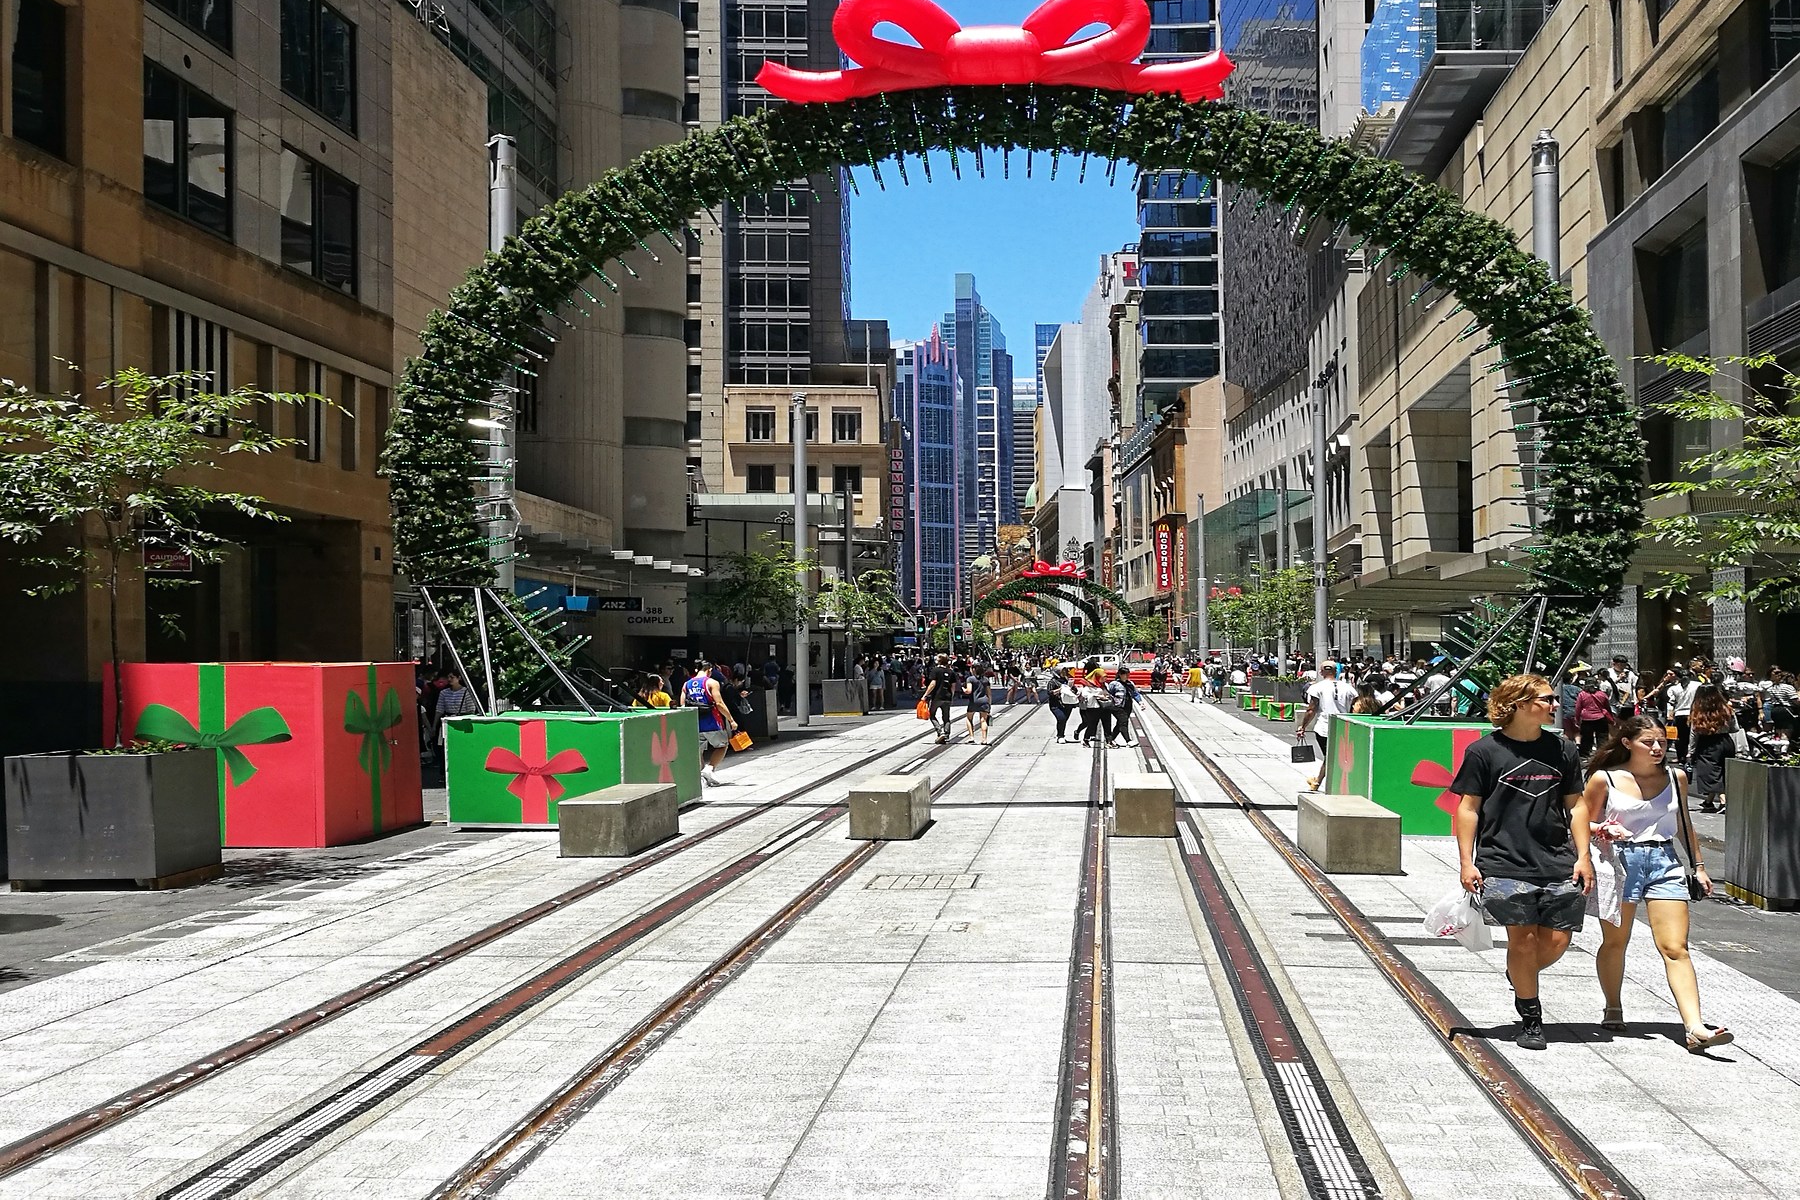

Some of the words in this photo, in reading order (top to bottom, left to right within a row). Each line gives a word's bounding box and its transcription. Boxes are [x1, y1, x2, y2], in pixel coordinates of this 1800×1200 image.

[892, 450, 903, 530] DYMOCKS
[1159, 532, 1169, 587] McDonald's
[601, 601, 626, 609] ANZ
[646, 607, 663, 615] 388
[627, 616, 674, 624] COMPLEX
